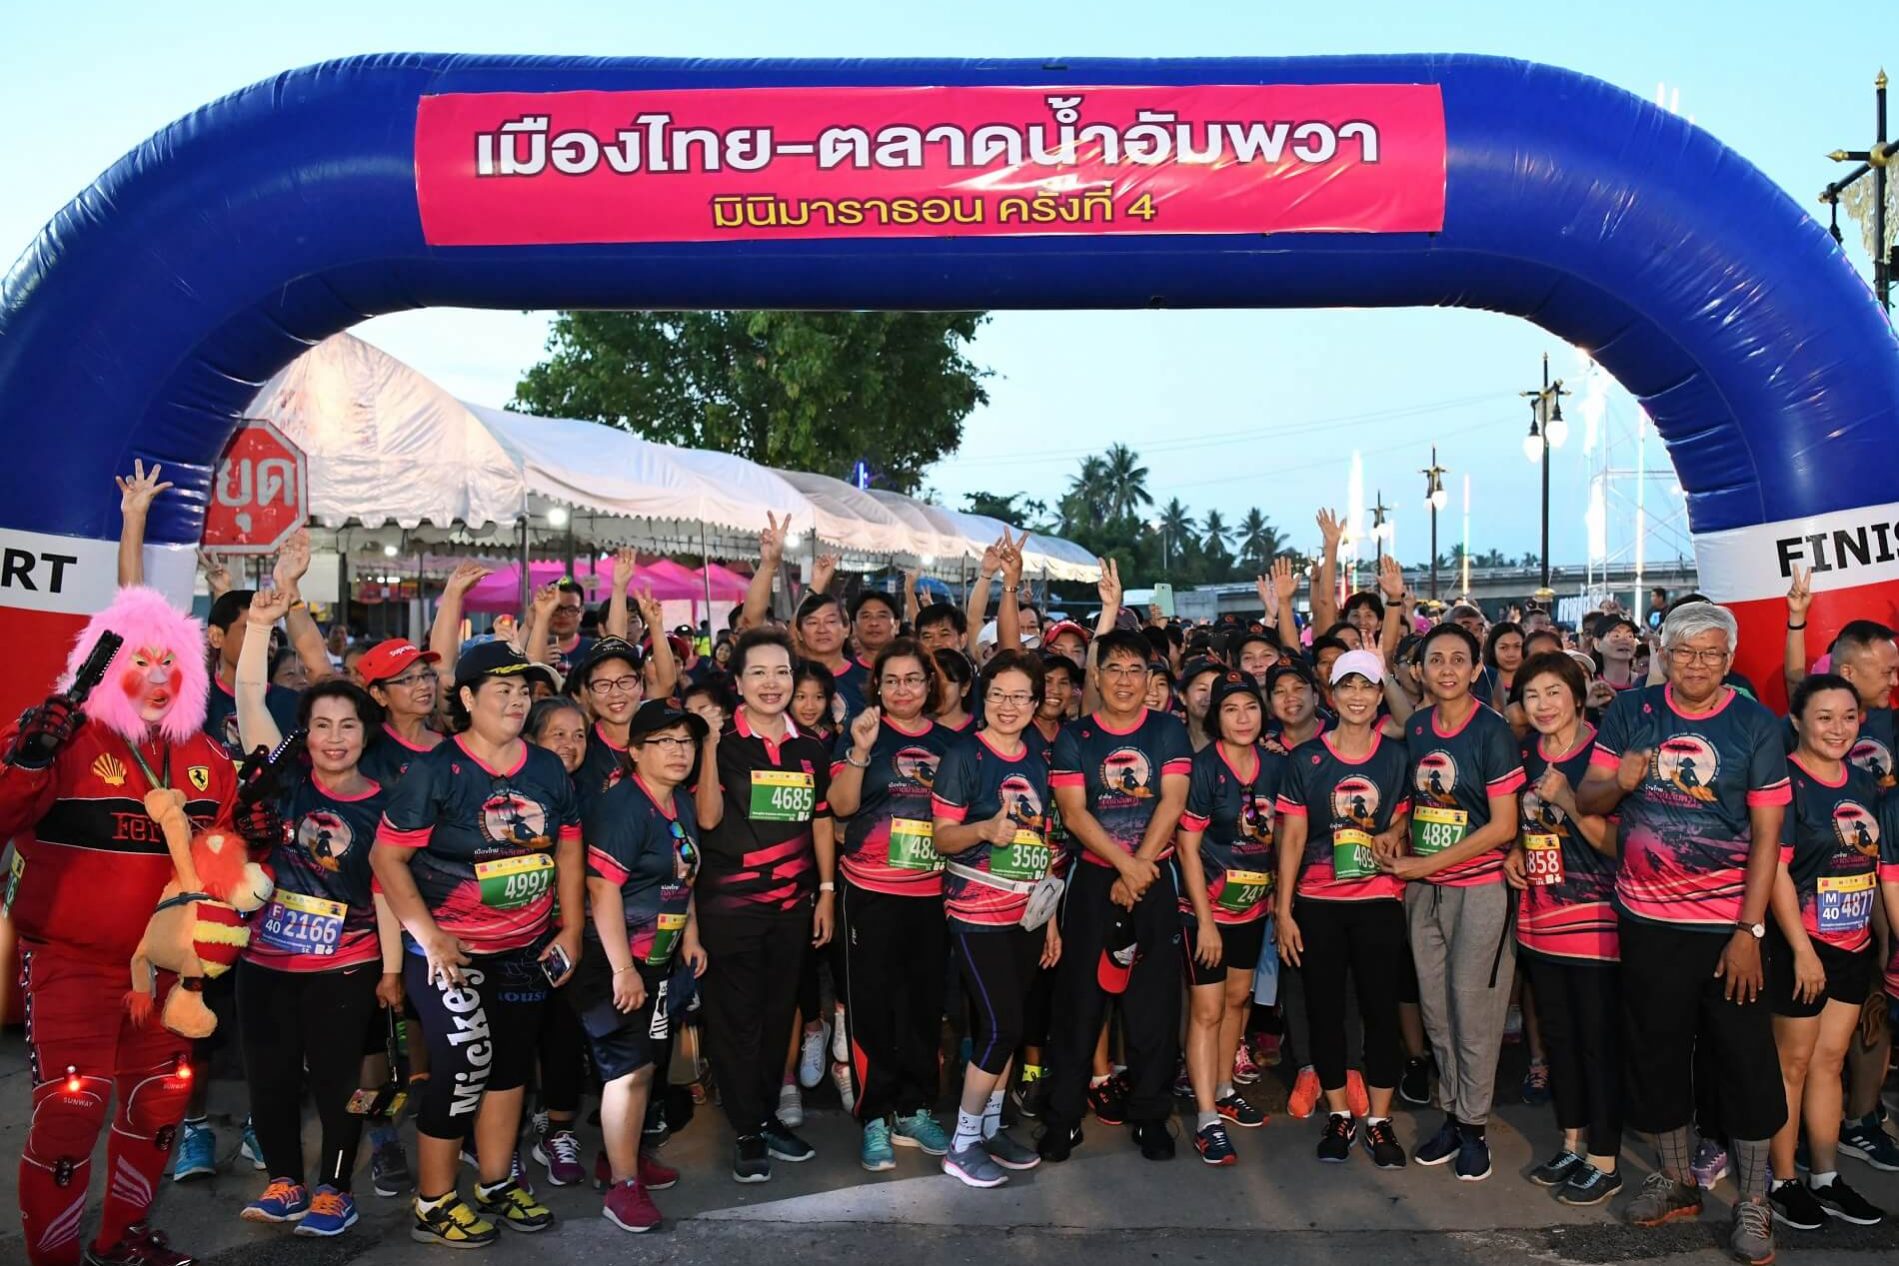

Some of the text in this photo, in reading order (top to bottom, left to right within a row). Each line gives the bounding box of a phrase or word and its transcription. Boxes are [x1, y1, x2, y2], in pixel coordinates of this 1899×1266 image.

[476, 97, 1379, 175] เมืองไทย-ตลาดน้ำอัมพวา
[714, 182, 1156, 227] มินิมาราธอน ครั้งที่ 4
[216, 458, 295, 533] ยุด
[1, 548, 77, 593] RT
[771, 787, 812, 810] 4685
[1422, 822, 1463, 847] 4887
[1012, 844, 1048, 869] 3566
[1526, 850, 1559, 874] 858
[504, 869, 549, 899] 4991
[1826, 893, 1837, 903] M
[272, 904, 338, 943] F 2166
[1822, 907, 1840, 920] 40
[265, 919, 281, 934] 40
[63, 1096, 93, 1108] SUNWAY
